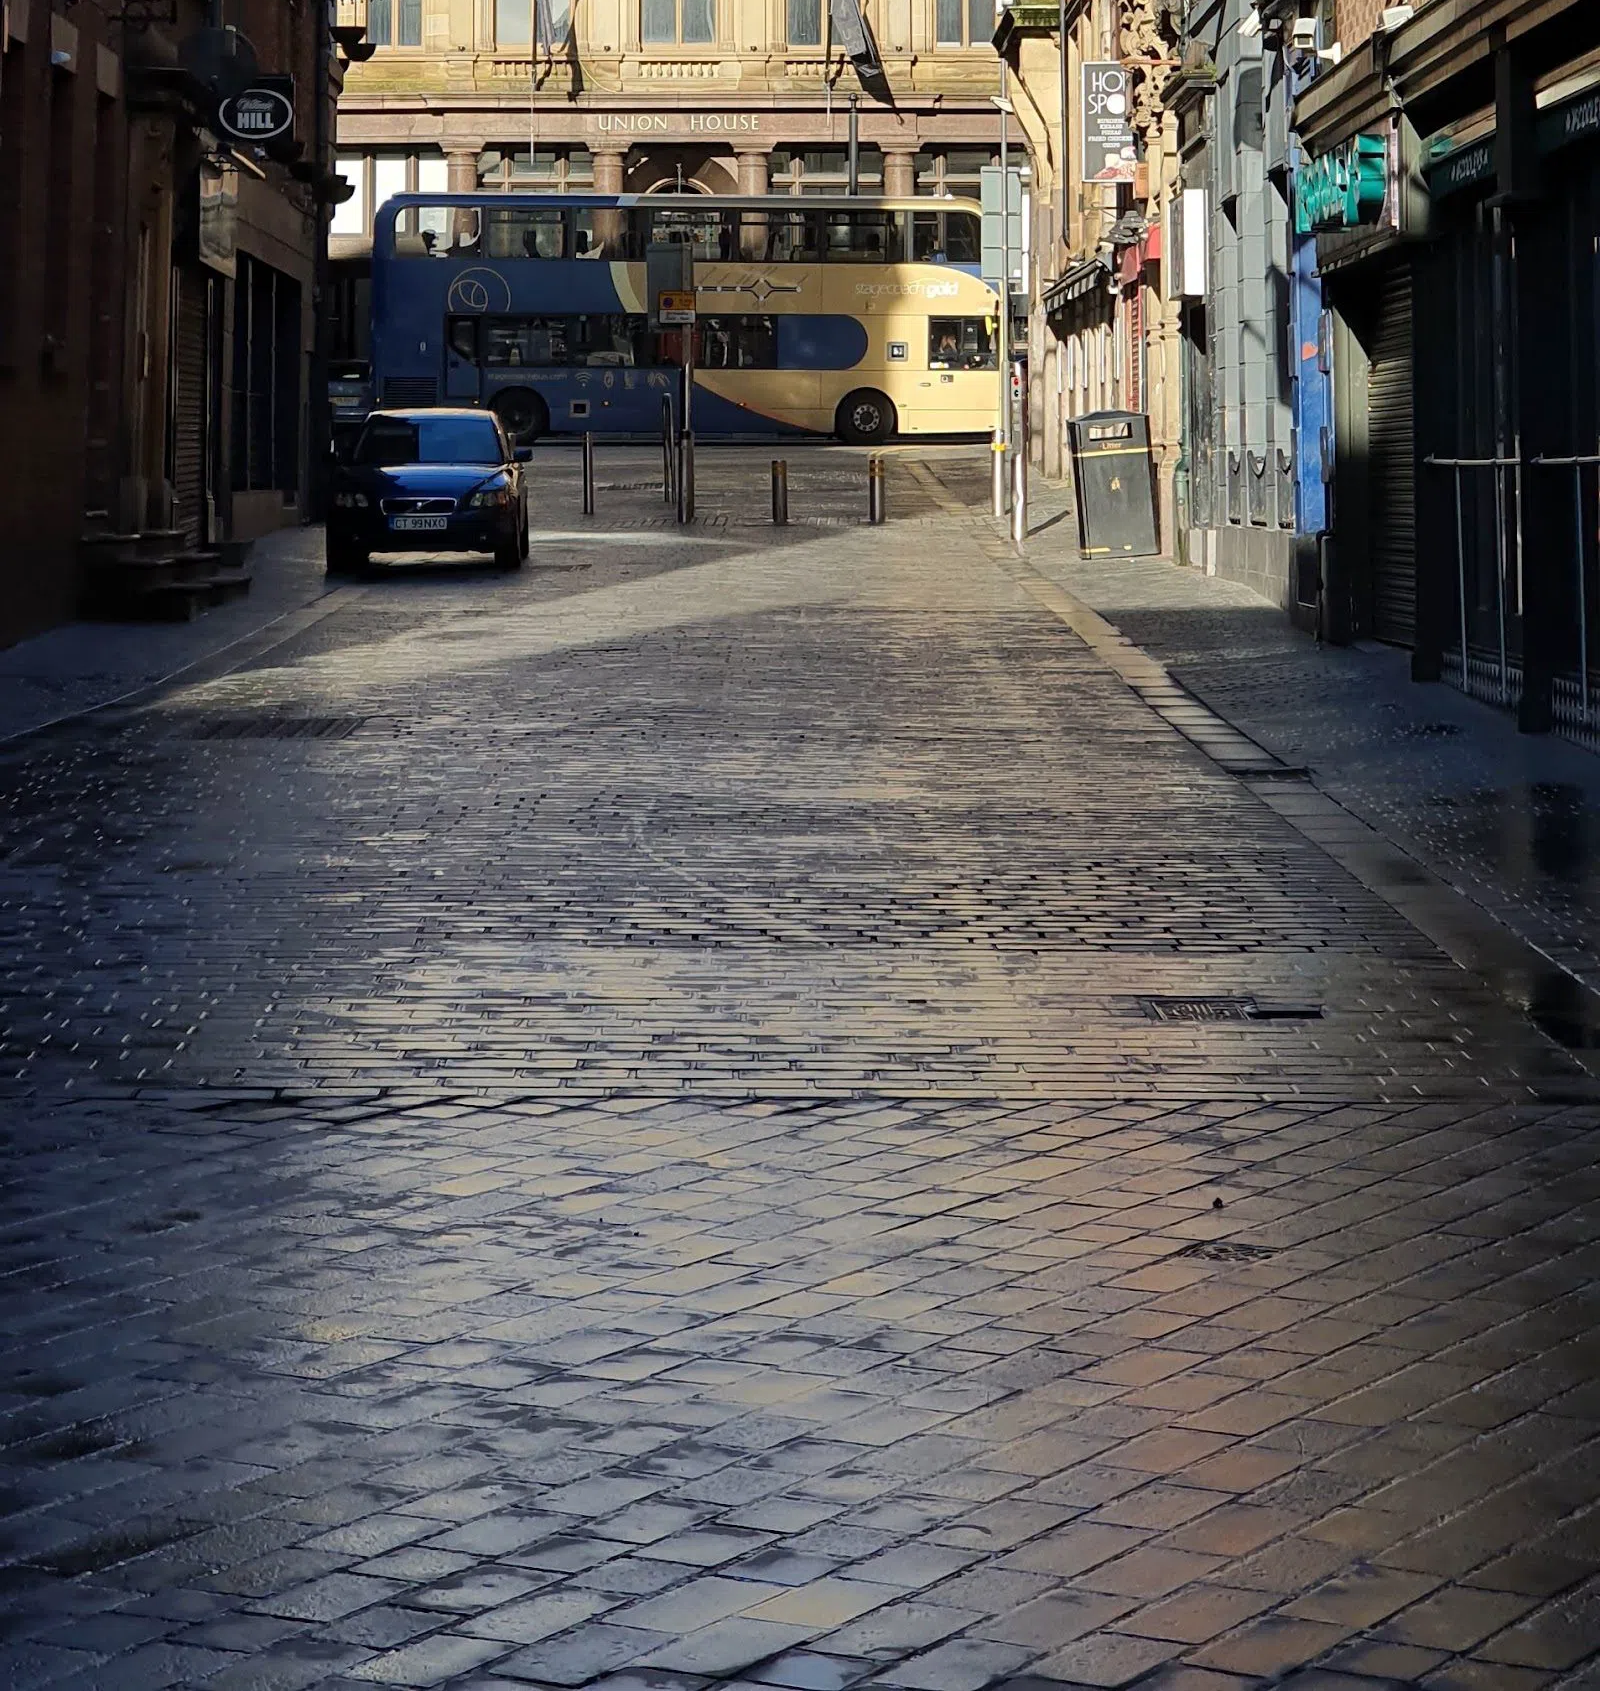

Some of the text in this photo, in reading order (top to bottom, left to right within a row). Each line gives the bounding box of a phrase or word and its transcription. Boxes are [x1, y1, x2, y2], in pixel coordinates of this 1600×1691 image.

[237, 112, 275, 129] HILL
[598, 114, 760, 131] UNION HOUSE
[855, 281, 959, 298] stagecoach gold
